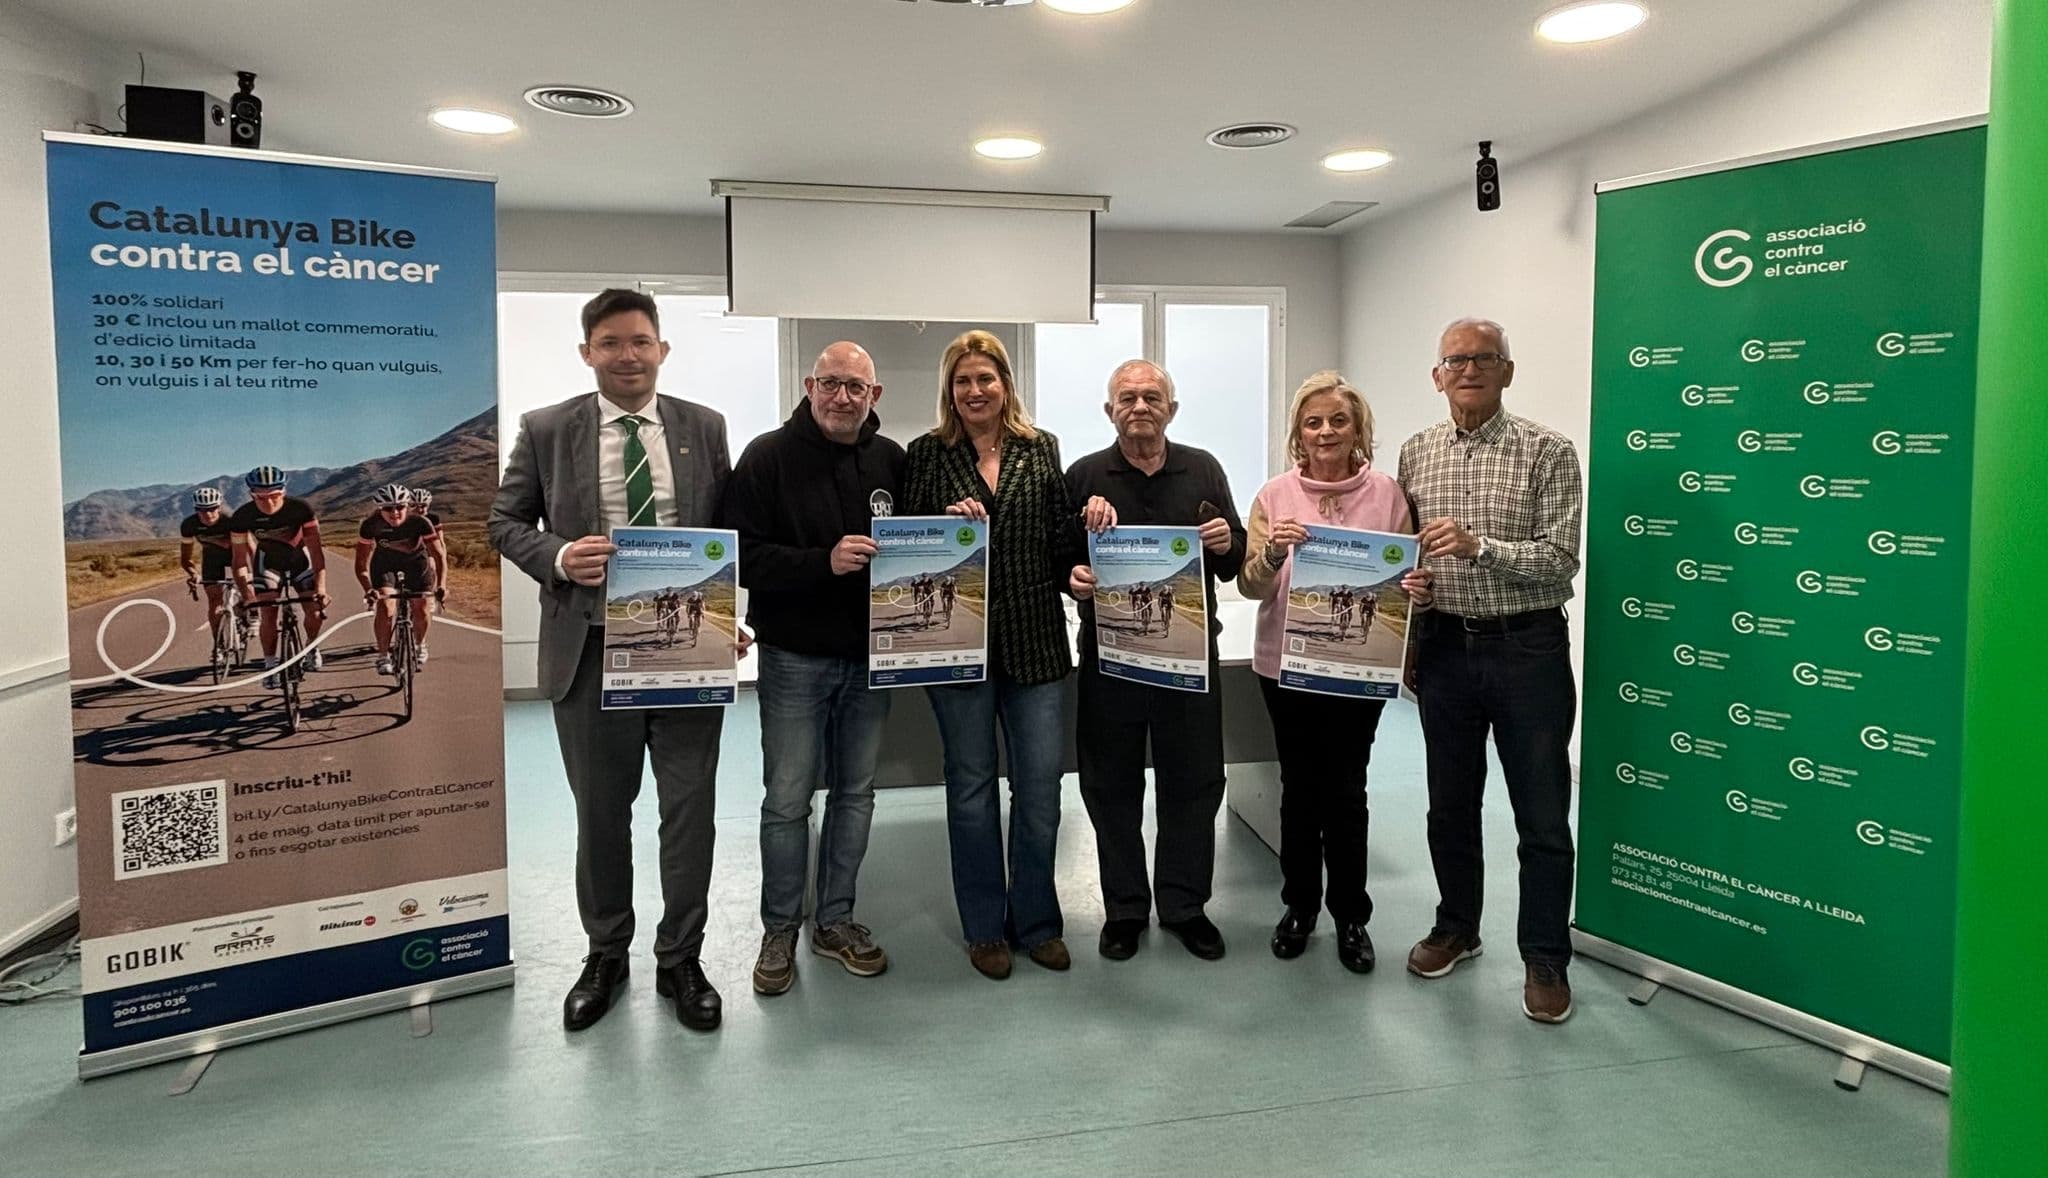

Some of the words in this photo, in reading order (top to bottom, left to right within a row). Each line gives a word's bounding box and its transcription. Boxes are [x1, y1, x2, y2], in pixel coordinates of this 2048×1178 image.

[89, 201, 319, 248] Catalunya
[331, 218, 416, 249] Bike
[1766, 218, 1866, 243] associació
[90, 242, 242, 273] contra
[253, 248, 295, 275] el
[304, 251, 440, 283] càncer
[1765, 243, 1824, 260] contra
[1764, 263, 1780, 277] el
[1784, 259, 1848, 276] càncer
[92, 293, 148, 307] 100%
[153, 296, 224, 310] solidari
[94, 314, 119, 328] 30
[125, 313, 141, 327] €
[147, 314, 207, 329] Inclou
[213, 318, 236, 330] un
[242, 318, 300, 332] mallot
[179, 334, 256, 350] limitada
[95, 354, 124, 368] 10,
[130, 355, 154, 368] 30
[160, 354, 165, 367] i
[171, 356, 194, 370] 50
[200, 355, 231, 369] Km
[237, 357, 267, 371] per
[272, 356, 327, 370] fer-ho
[332, 360, 374, 374] quan
[379, 360, 442, 376] vulguis,
[95, 375, 122, 386] on
[127, 374, 199, 390] vulguis
[204, 374, 208, 387] i
[214, 374, 231, 388] al
[236, 375, 266, 388] teu
[271, 376, 319, 389] ritme
[233, 769, 352, 796] Inscriu-t'hi!
[234, 834, 244, 844] 4
[247, 831, 269, 841] de
[317, 820, 350, 832] data
[388, 810, 413, 823] per
[416, 799, 490, 818] apuntar-se
[235, 851, 245, 860] o
[248, 847, 276, 858] fins
[280, 837, 337, 853] esgotar
[1611, 865, 1630, 878] 973
[1632, 872, 1644, 883] 23
[1645, 874, 1657, 886] 81
[1659, 880, 1673, 890] 48
[1613, 842, 1678, 868] ASSOCIACIÓ
[1680, 862, 1729, 884] CONTRA
[1731, 877, 1746, 890] EL
[1746, 882, 1801, 907] CÀNCER
[1803, 899, 1813, 910] A
[1816, 901, 1866, 925] LLEIDA
[1666, 870, 1699, 888] 25004
[1701, 880, 1735, 898] Lleida
[1611, 877, 1768, 935] asociacioncontraelcancer.es
[214, 935, 275, 954] PRATS
[441, 943, 472, 953] contra
[107, 942, 184, 974] GOBIK
[441, 954, 450, 962] el
[113, 1007, 138, 1019] 900
[140, 1001, 162, 1012] 100
[164, 995, 187, 1007] 036
